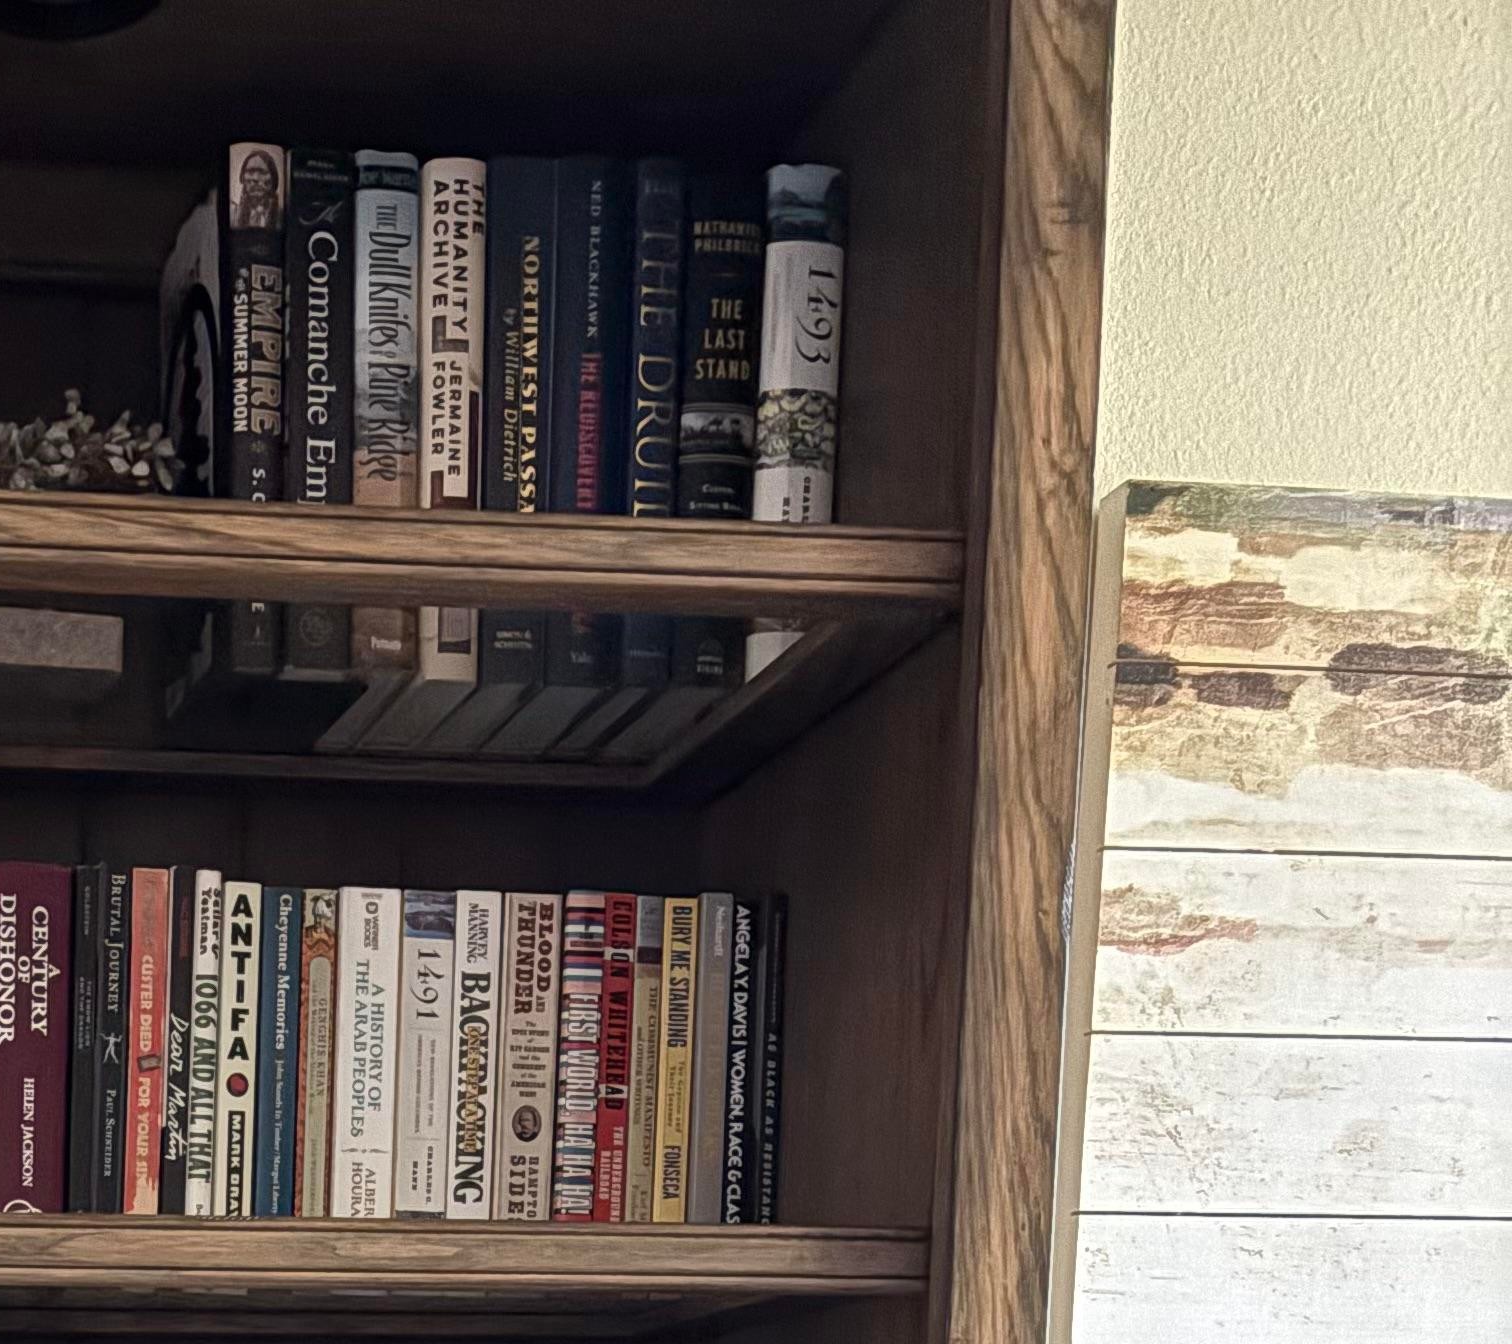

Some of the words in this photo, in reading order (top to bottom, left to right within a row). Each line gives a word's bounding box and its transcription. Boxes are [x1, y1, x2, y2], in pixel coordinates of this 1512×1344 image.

[432, 181, 448, 316] ARCHIVE
[451, 179, 469, 333] HUMANITY
[796, 265, 835, 365] 1493
[306, 231, 338, 427] Comanche
[228, 894, 253, 1061] ANTIFA
[417, 949, 440, 1020] 1491
[515, 903, 536, 1015] THUNDER
